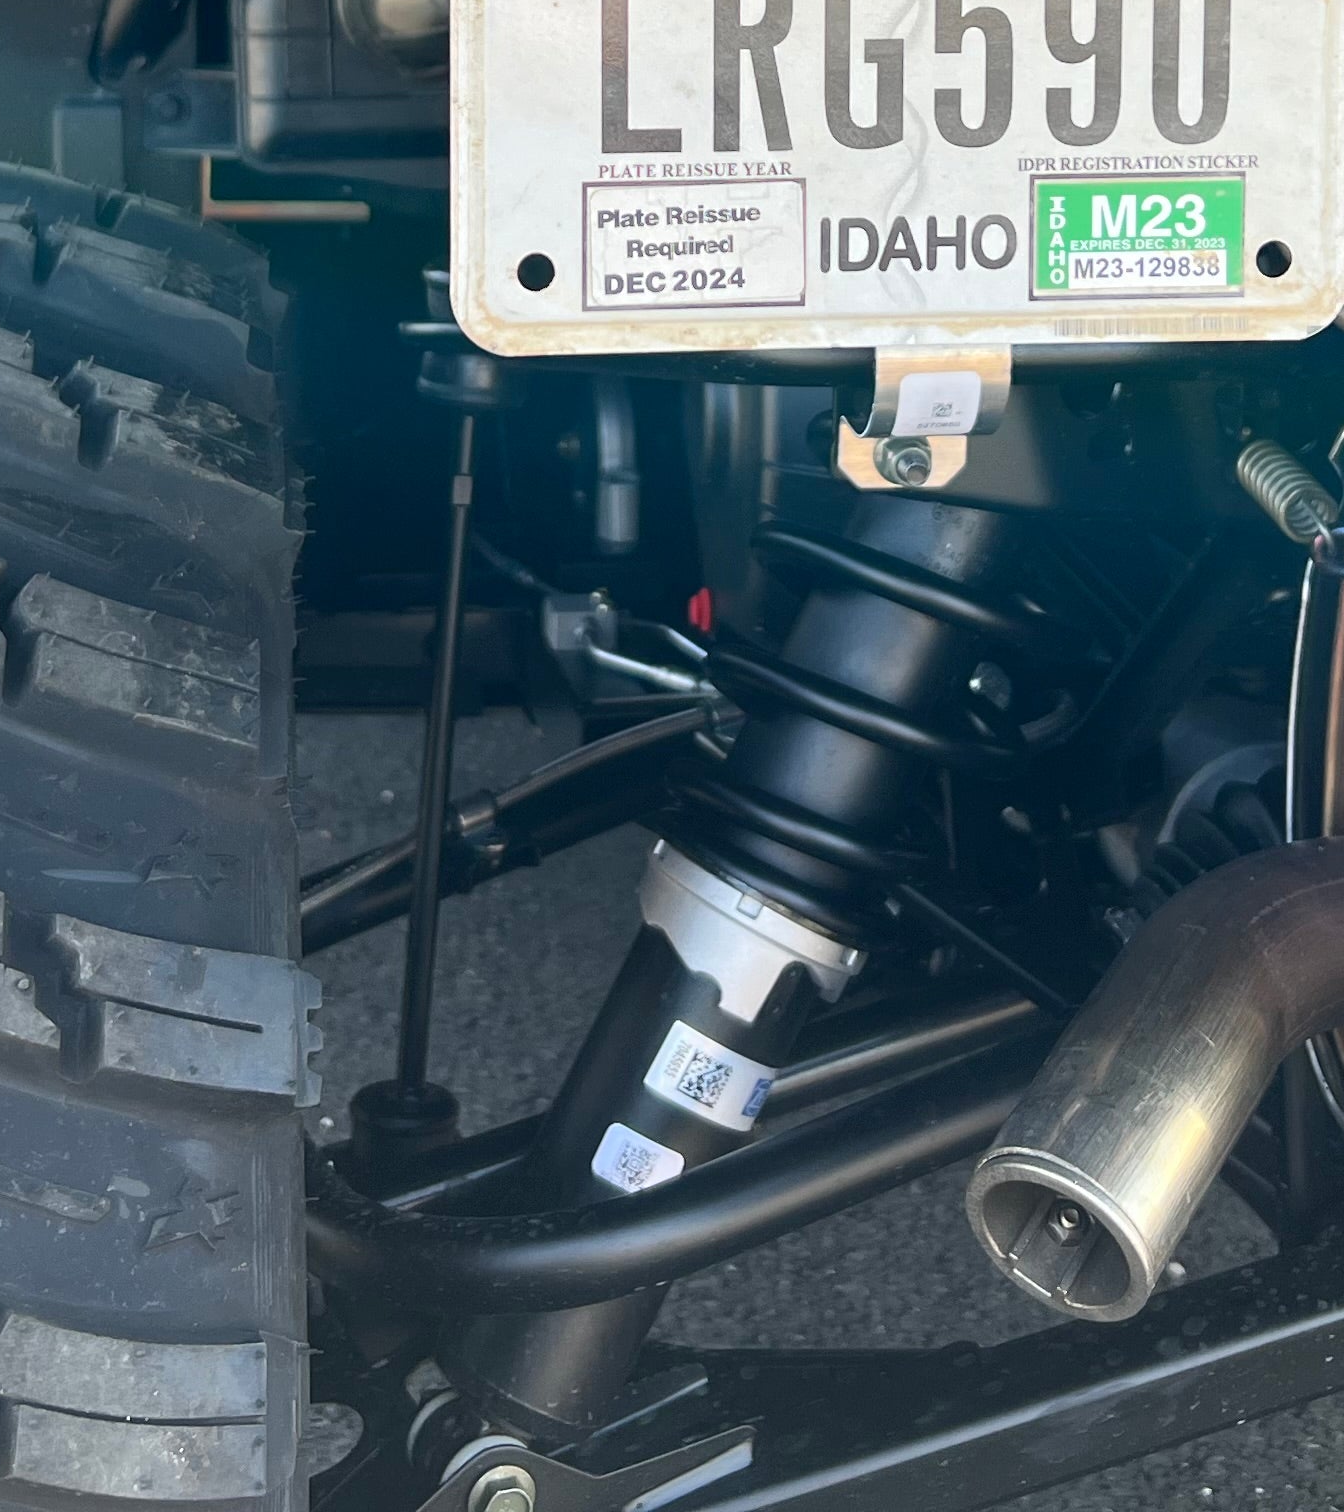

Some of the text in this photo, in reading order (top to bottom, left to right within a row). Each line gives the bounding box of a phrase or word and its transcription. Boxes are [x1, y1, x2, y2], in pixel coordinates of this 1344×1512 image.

[598, 162, 792, 179] PLATE REISSUE YEAR
[1018, 154, 1259, 171] IDPR REGISTRATION STICKER
[597, 205, 761, 229] Plate Reissue
[1091, 194, 1207, 238] M23
[626, 235, 734, 261] Required
[818, 214, 1017, 274] IDAHO
[1048, 196, 1067, 284] IDAHO
[1069, 239, 1131, 251] EXPIRES
[1135, 239, 1168, 250] DEC.
[1194, 238, 1226, 249] 2023
[1074, 256, 1220, 279] M23-129838
[604, 267, 746, 296] DEC 2024
